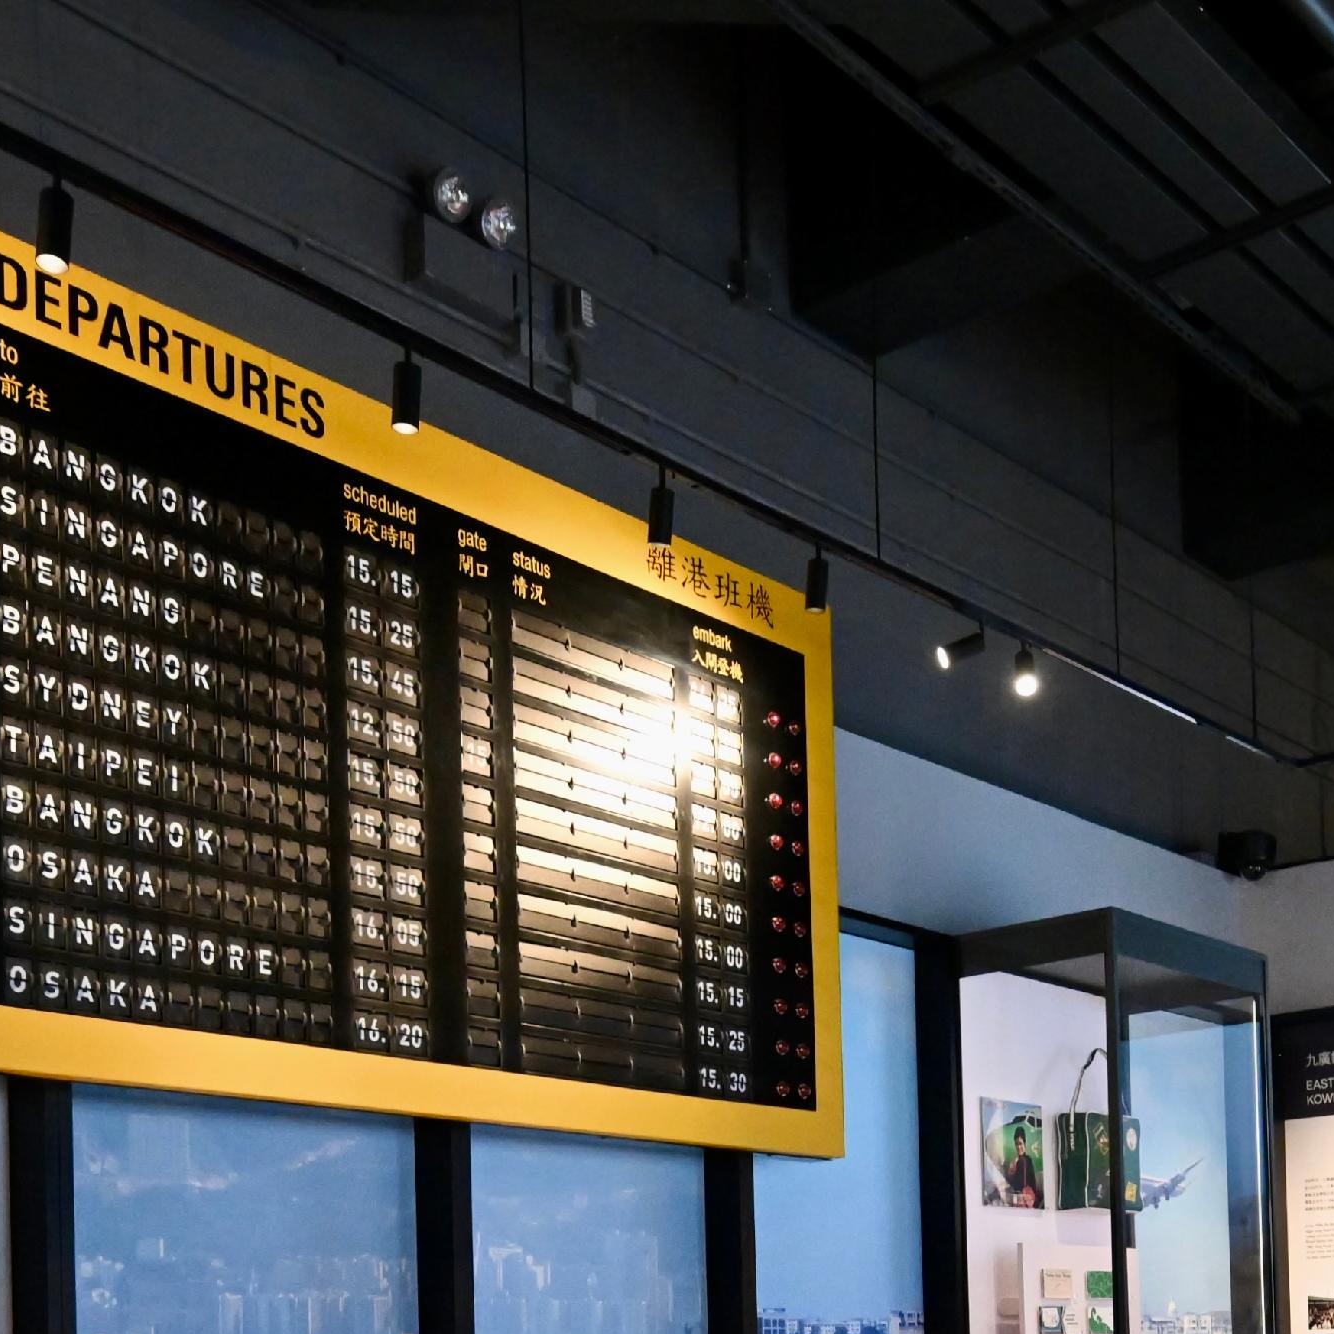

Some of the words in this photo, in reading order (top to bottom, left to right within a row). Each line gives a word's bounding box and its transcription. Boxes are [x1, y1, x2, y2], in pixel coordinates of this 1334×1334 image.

[0, 338, 18, 365] to
[344, 482, 417, 525] scheduled
[344, 511, 415, 554] 預定時間
[458, 528, 487, 552] gate
[3, 544, 180, 625] PENANG
[512, 551, 551, 580] status
[646, 547, 774, 630] 離港班機
[692, 625, 732, 652] embark
[1, 604, 211, 690] BANGKOK
[466, 741, 490, 768] 15
[4, 664, 183, 737] SYDNEY
[5, 725, 178, 793] TAIPEI
[6, 785, 215, 857] BANGKOK
[7, 845, 156, 899] OSAKA
[8, 906, 273, 976] SINGAPORE
[9, 965, 158, 1013] OSAKA
[1306, 1079, 1334, 1091] EAST
